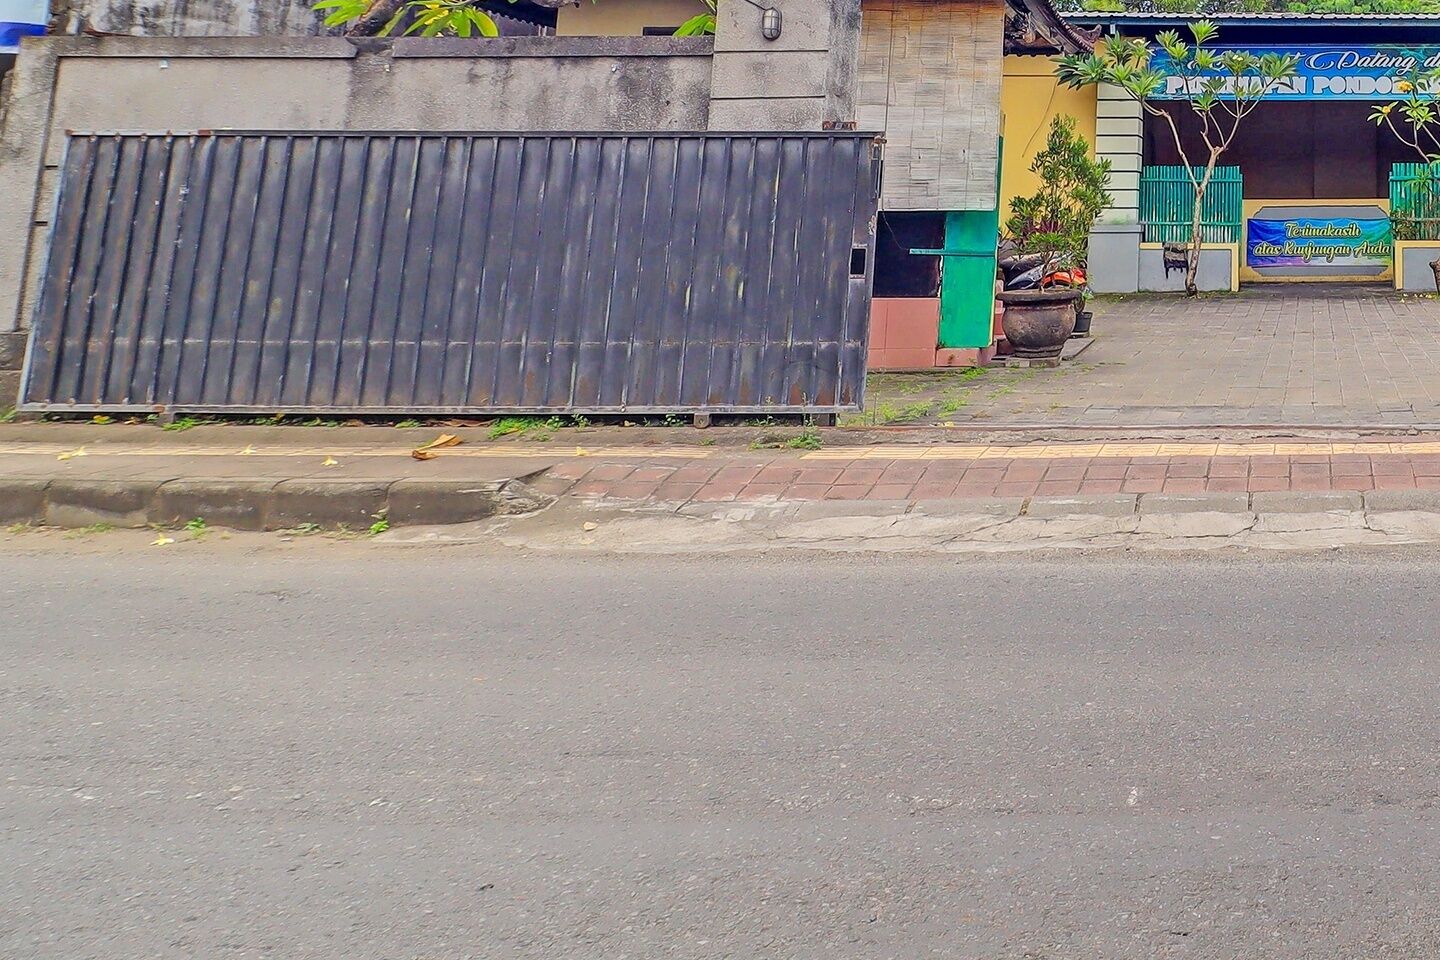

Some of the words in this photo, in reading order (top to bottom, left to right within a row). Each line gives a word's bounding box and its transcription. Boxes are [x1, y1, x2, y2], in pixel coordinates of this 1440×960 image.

[1305, 50, 1417, 75] Datang
[1285, 222, 1361, 238] Terimakasih
[1253, 241, 1282, 256] atas
[1283, 241, 1352, 262] Kunjungan
[1354, 241, 1391, 258] Anda
